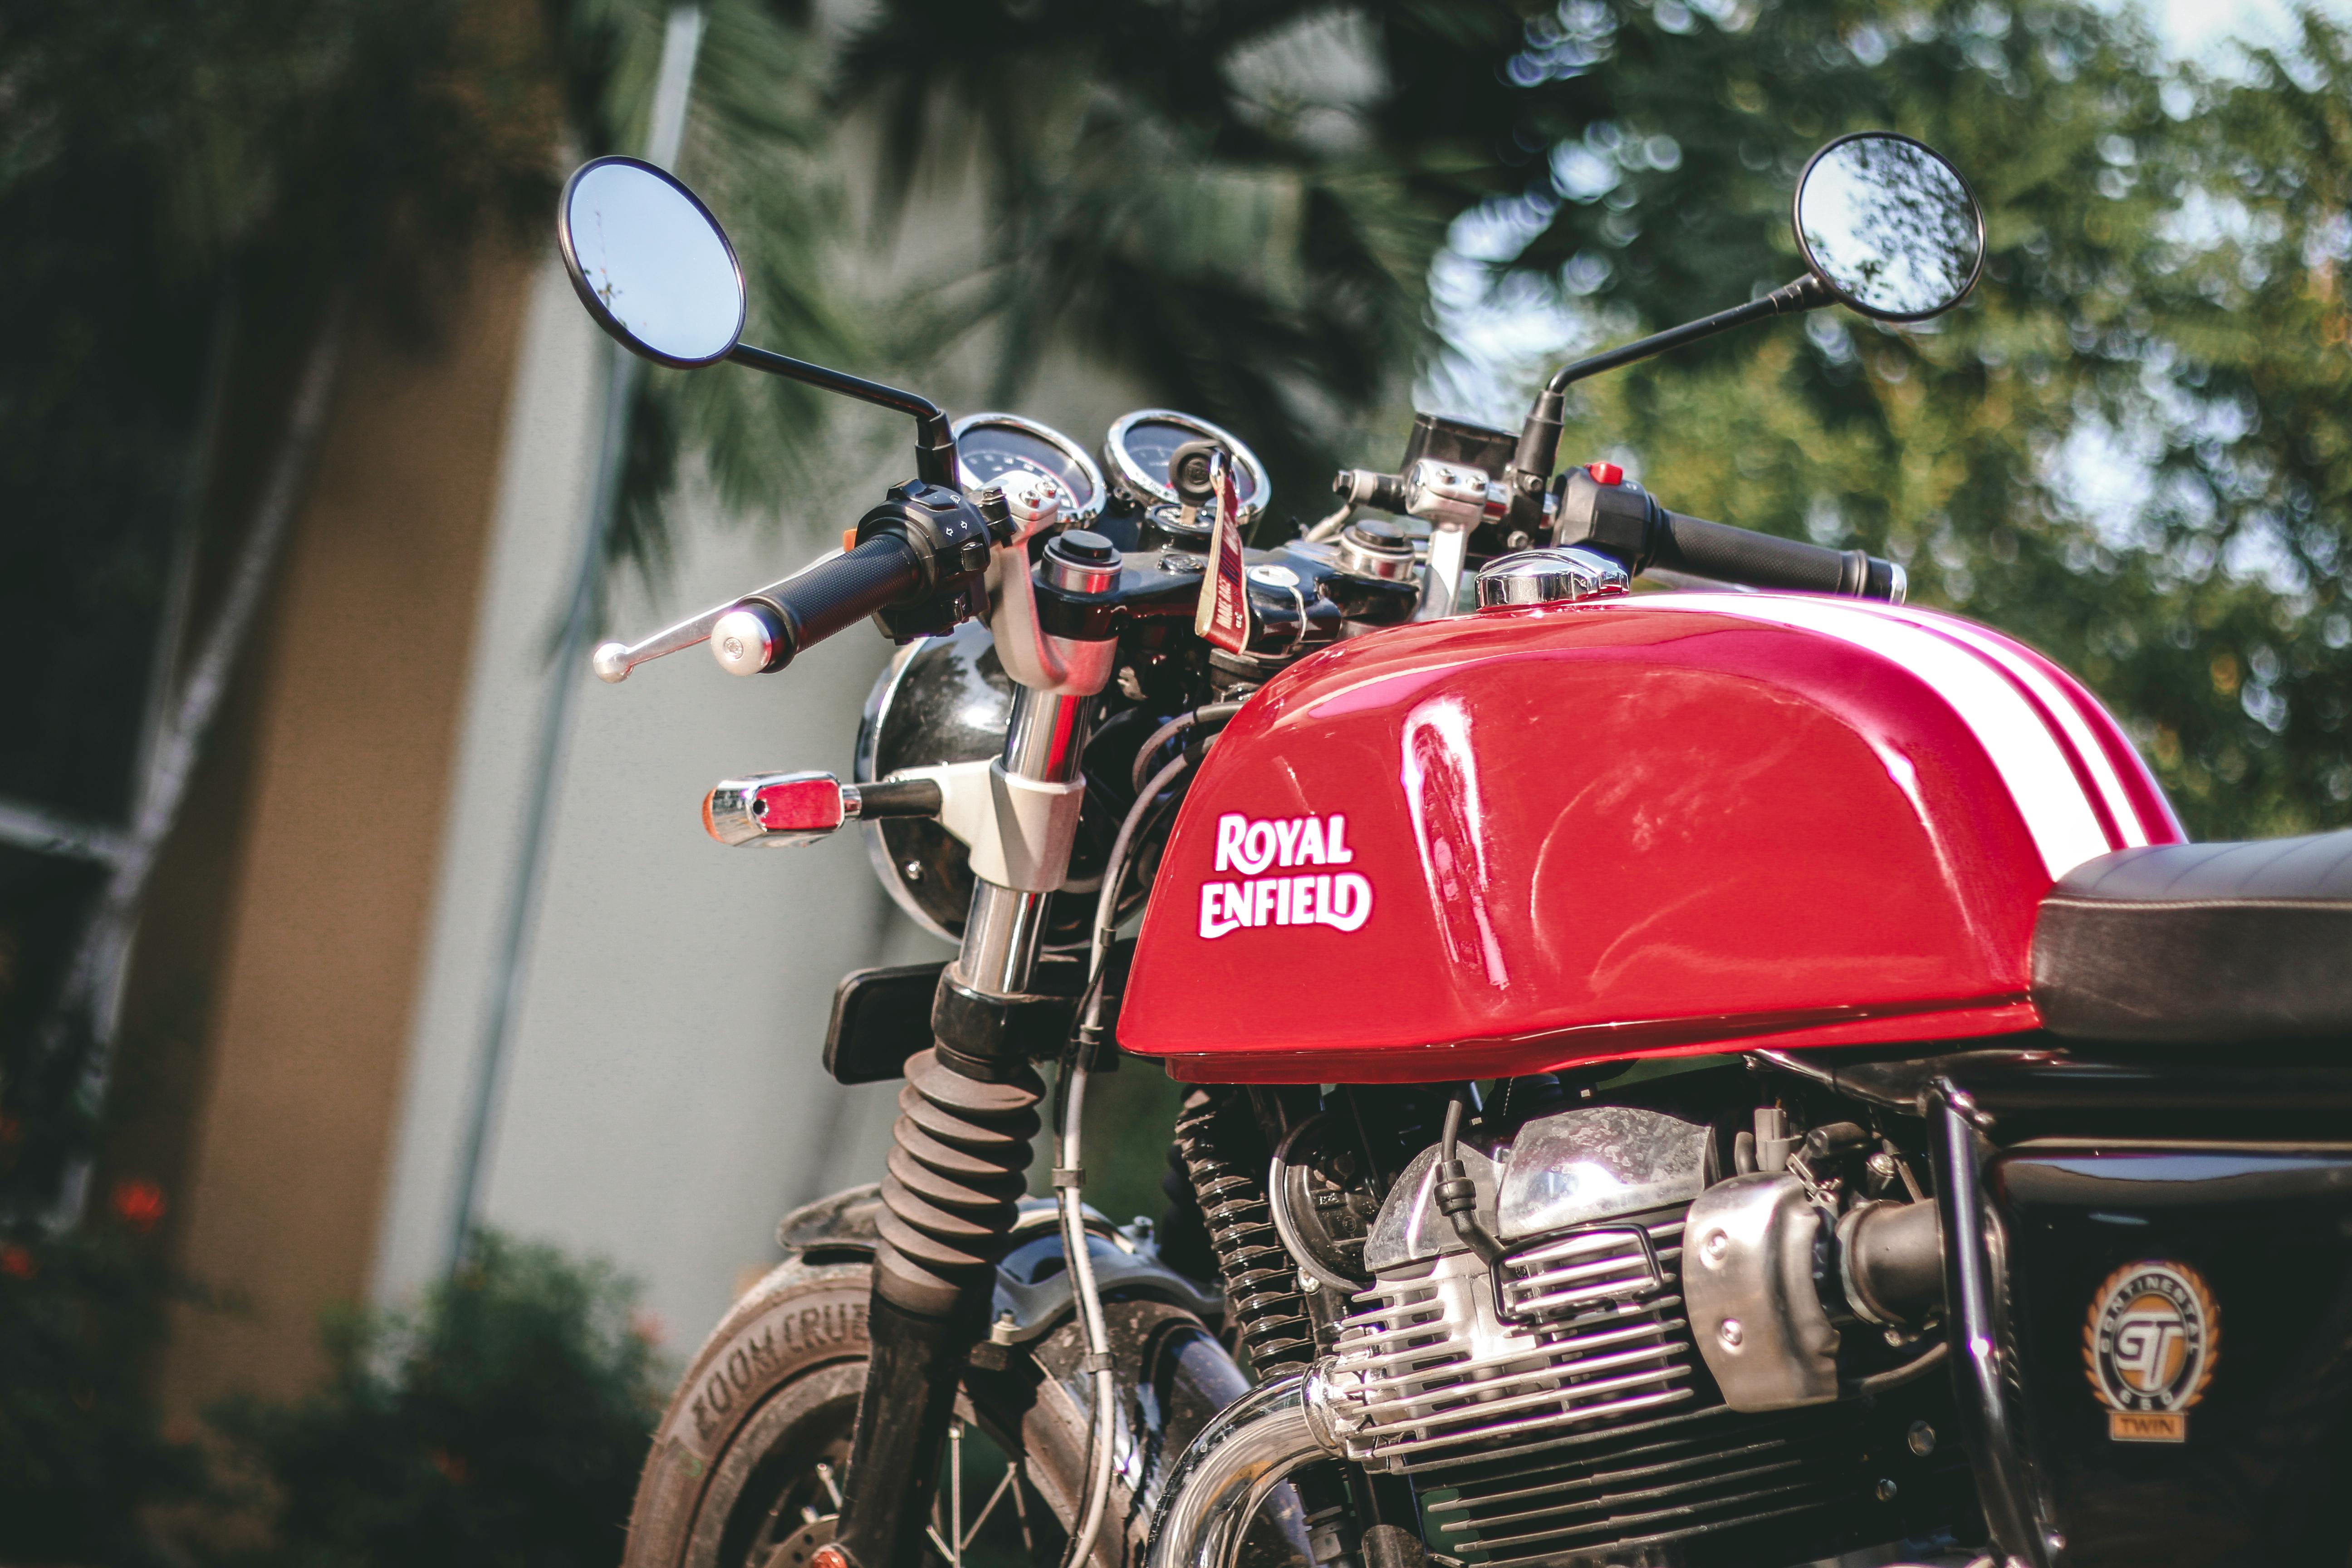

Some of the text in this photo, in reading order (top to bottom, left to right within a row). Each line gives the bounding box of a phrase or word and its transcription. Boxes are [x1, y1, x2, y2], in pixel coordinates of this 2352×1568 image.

[1215, 814, 1353, 875] ROYAL
[1199, 873, 1373, 939] ENFIELD
[2100, 1276, 2200, 1355] CONTINENTAL
[2116, 1311, 2185, 1392] GT
[2121, 1417, 2175, 1435] TWIN
